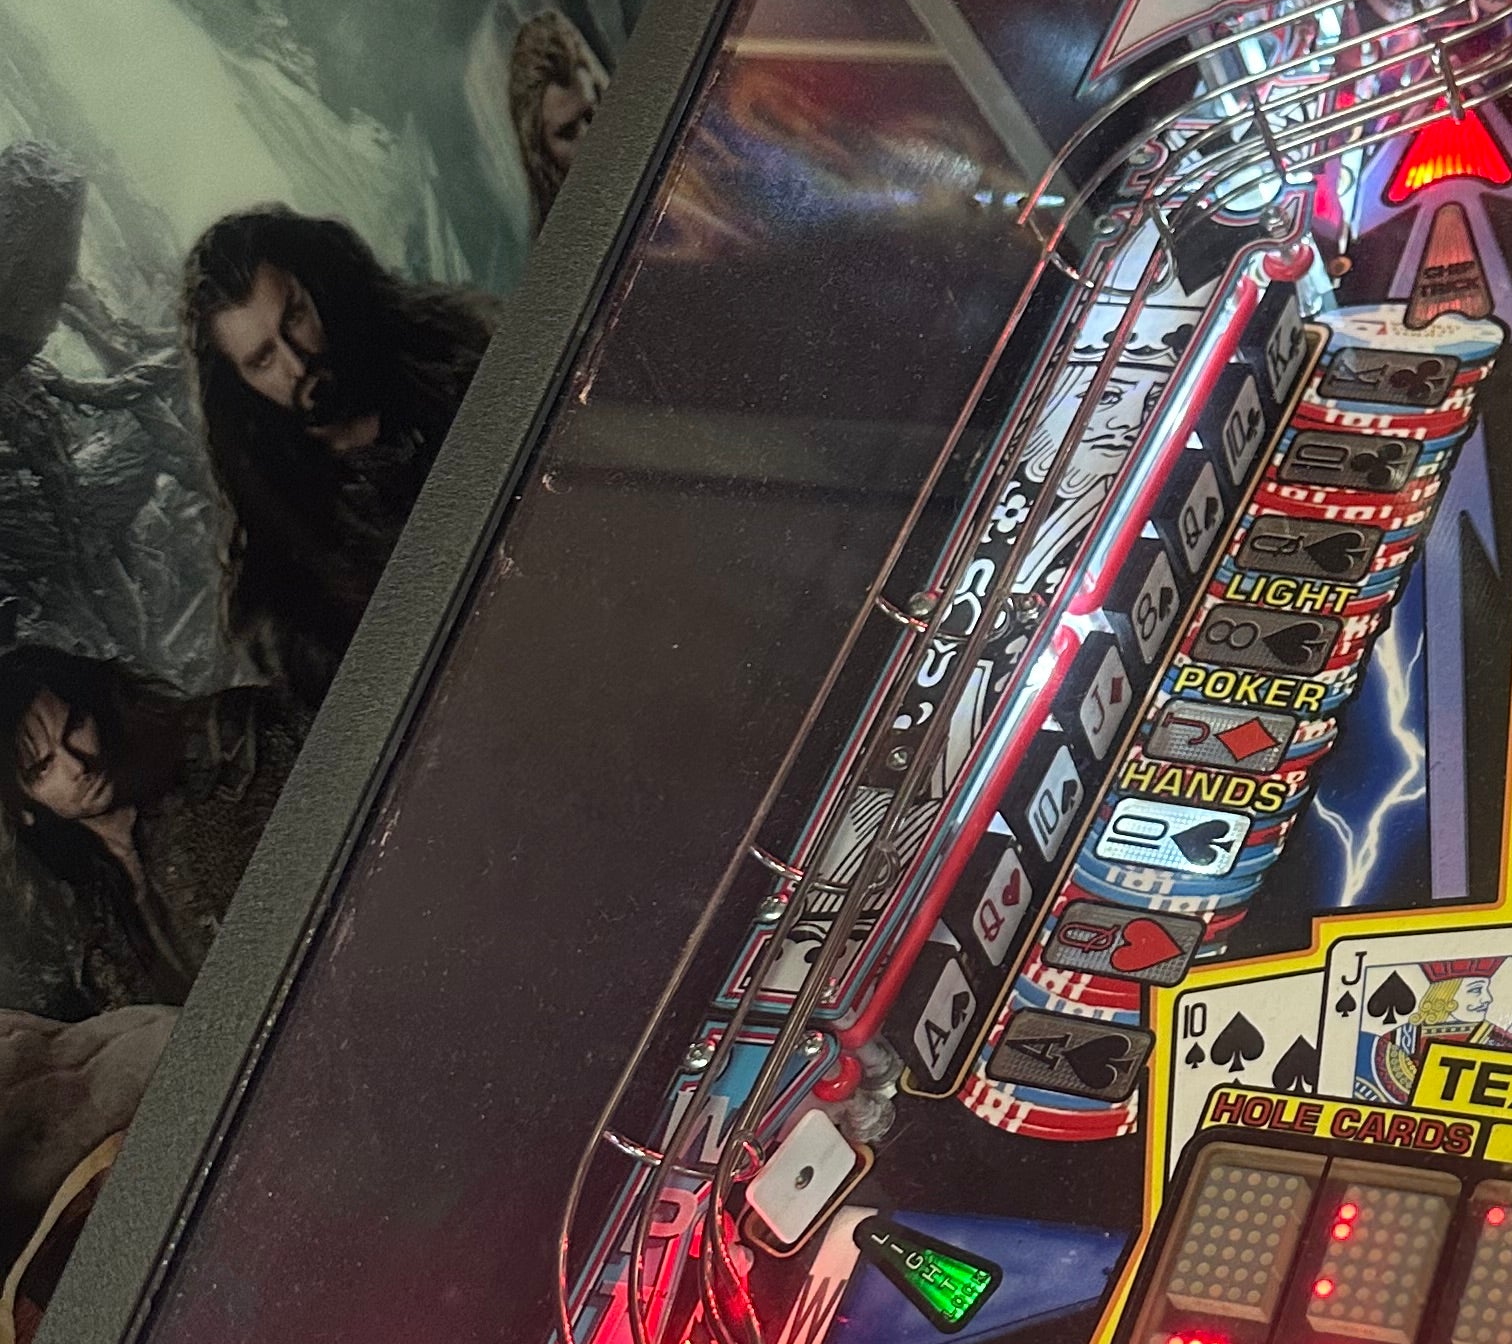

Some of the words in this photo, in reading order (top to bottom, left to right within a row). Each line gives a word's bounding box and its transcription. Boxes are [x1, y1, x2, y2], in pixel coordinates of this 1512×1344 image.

[1224, 573, 1361, 614] LIGHT
[1137, 598, 1158, 641] 8
[1203, 617, 1261, 652] 8
[1173, 666, 1329, 716] POKER
[1118, 761, 1290, 811] HANDS
[1032, 793, 1056, 847] 10
[1105, 812, 1170, 851] 10
[978, 896, 1006, 944] Q
[1341, 951, 1368, 988] J
[923, 1016, 951, 1066] A
[1182, 1003, 1208, 1040] 10
[1007, 1032, 1074, 1072] A
[1209, 1091, 1322, 1133] HOLE
[1329, 1109, 1474, 1155] CARDS
[871, 1234, 957, 1292] LIGHT
